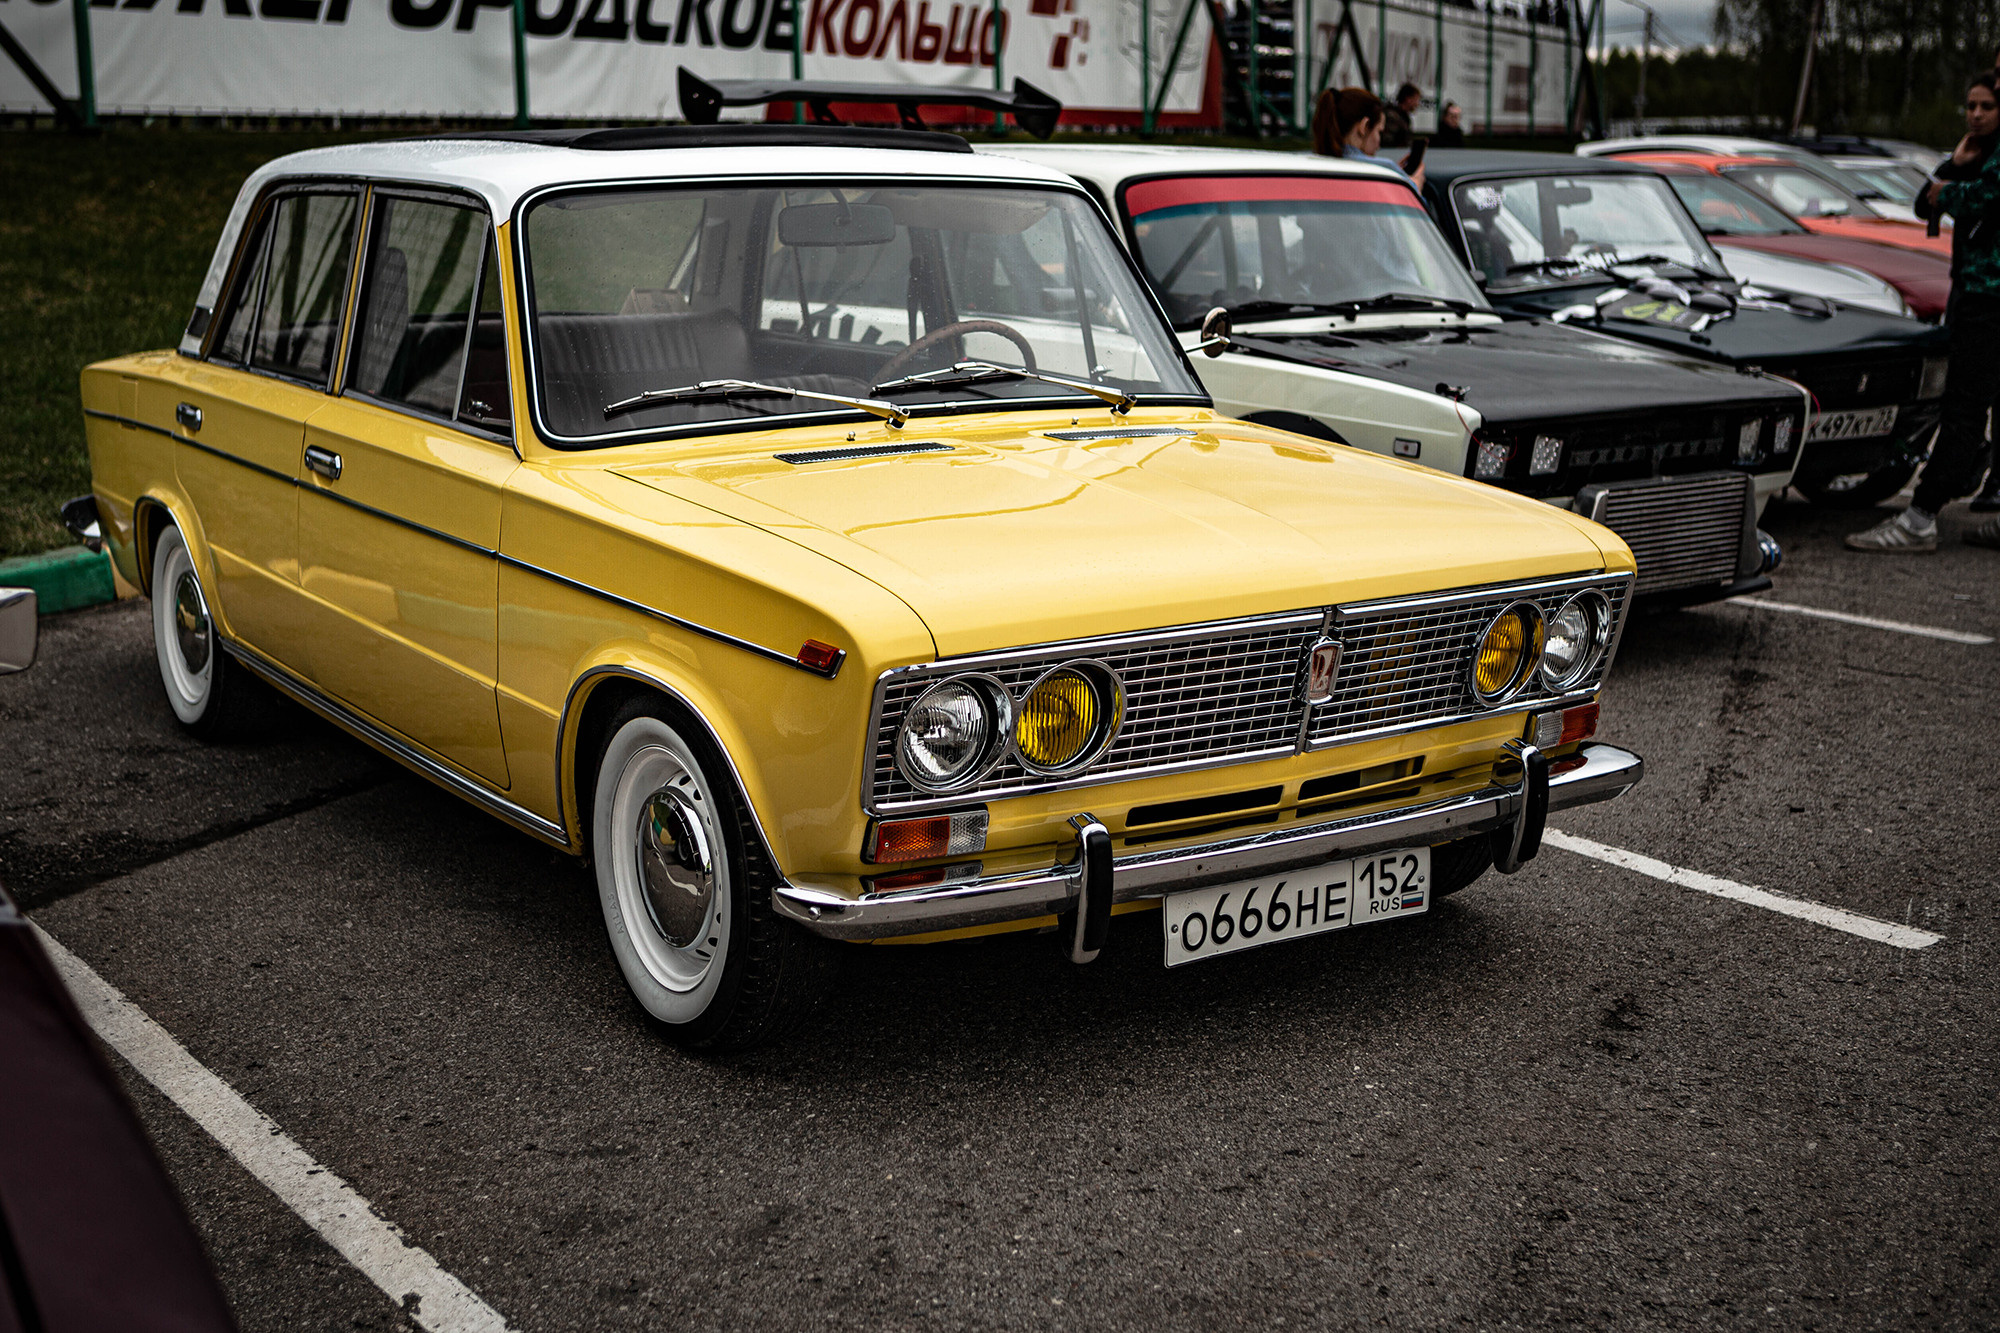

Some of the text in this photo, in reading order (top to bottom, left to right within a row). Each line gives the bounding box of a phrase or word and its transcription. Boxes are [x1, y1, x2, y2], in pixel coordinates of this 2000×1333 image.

[806, 0, 1008, 66] КОЛЬЦО
[607, 893, 625, 935] ATLAS
[1181, 854, 1419, 951] О666НЕ 152
[1369, 896, 1400, 915] RUS
